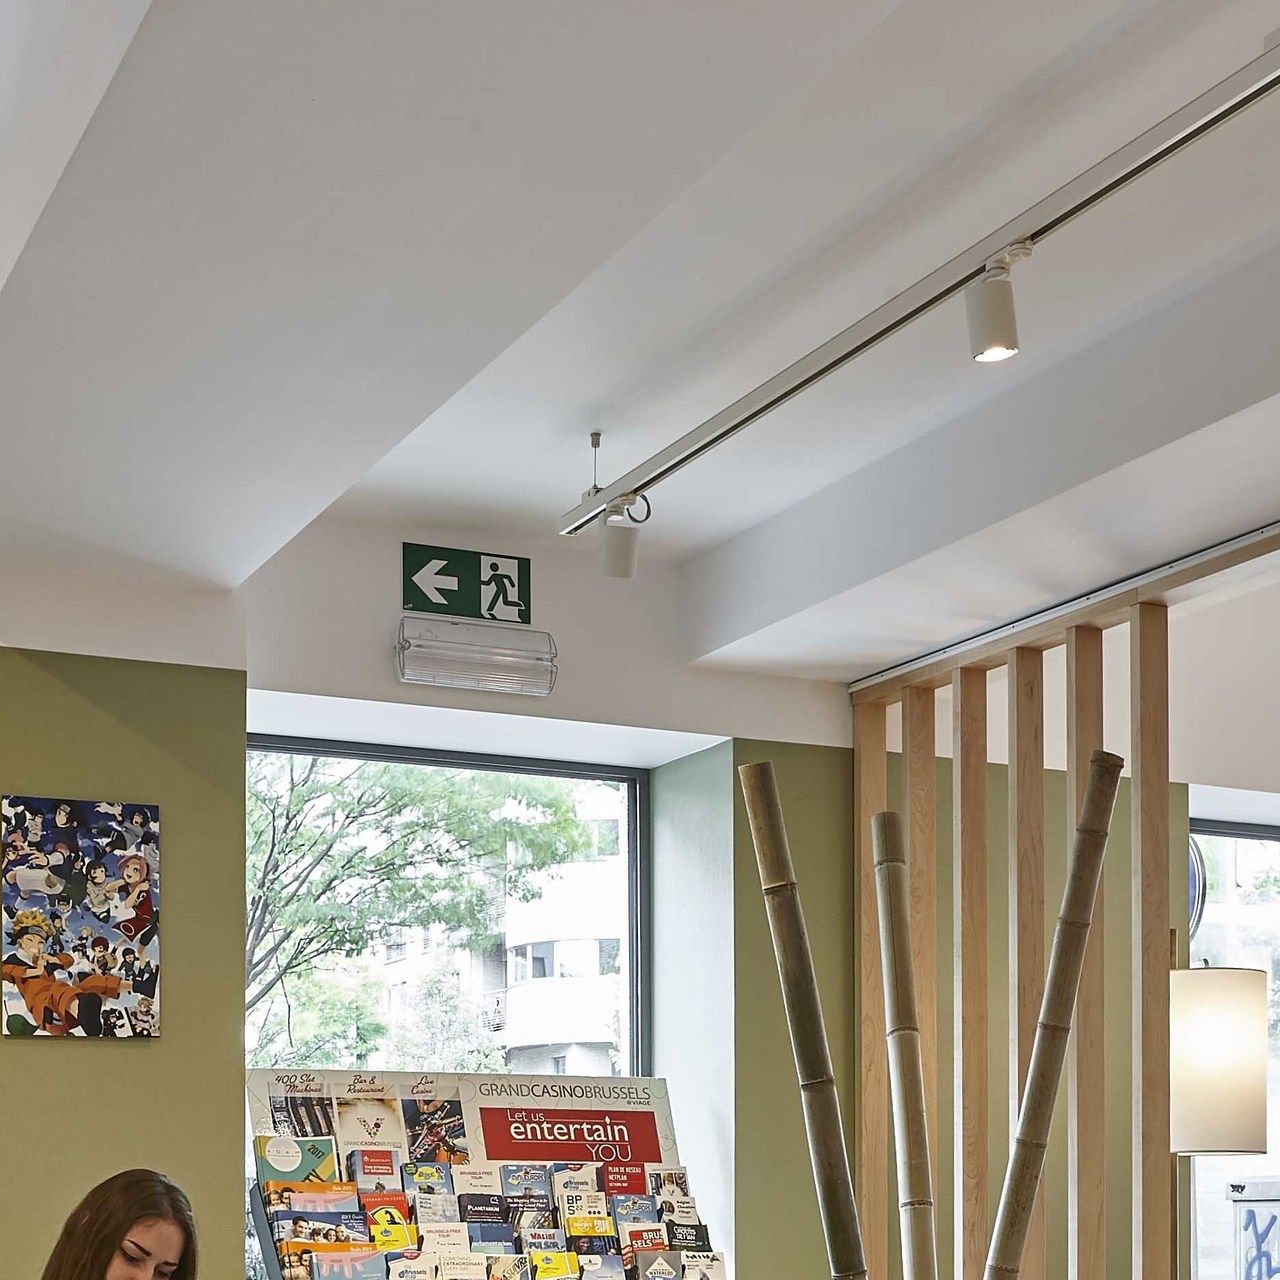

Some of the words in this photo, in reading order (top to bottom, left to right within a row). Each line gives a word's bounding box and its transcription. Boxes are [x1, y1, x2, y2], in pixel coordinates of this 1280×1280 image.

[275, 1074, 297, 1084] 400
[298, 1074, 316, 1084] Slot
[352, 1075, 366, 1085] Bar
[417, 1075, 434, 1086] Live
[285, 1084, 321, 1094] Machines
[346, 1084, 386, 1094] Restaurant
[478, 1082, 652, 1101] GRANDCASINOBRUSSELS
[506, 1109, 529, 1122] Let
[532, 1112, 545, 1122] us
[509, 1115, 629, 1142] entertain
[307, 1144, 326, 1160] 2017
[586, 1143, 632, 1162] YOU
[566, 1194, 582, 1205] BP
[467, 1204, 500, 1212] PLANETARIUM
[530, 1232, 556, 1240] WALIBI
[642, 1231, 664, 1239] BRUS
[632, 1239, 653, 1248] SELS
